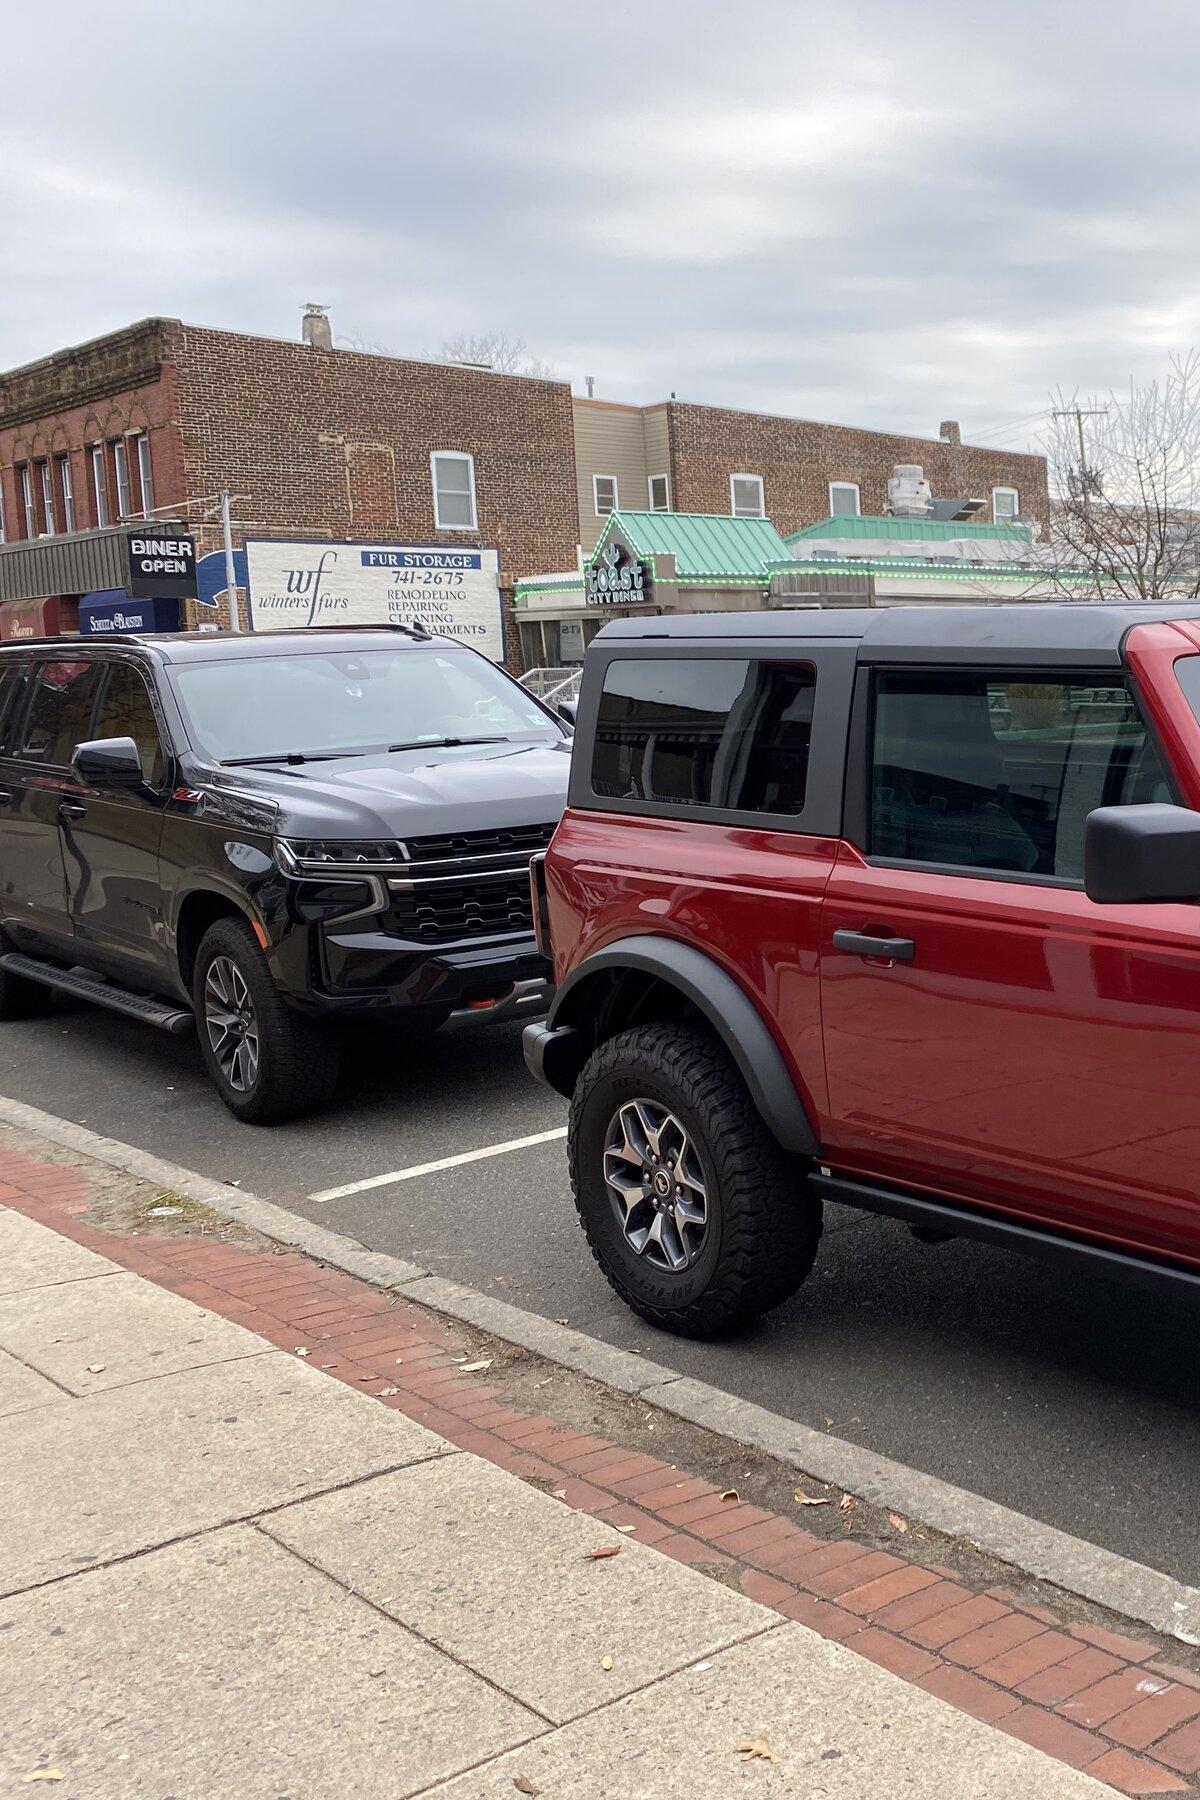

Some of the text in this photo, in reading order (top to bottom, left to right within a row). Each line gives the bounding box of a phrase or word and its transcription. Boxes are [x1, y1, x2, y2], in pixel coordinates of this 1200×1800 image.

[141, 558, 187, 573] OPEN
[369, 553, 473, 568] FUR STORAGE
[392, 571, 464, 585] 741-2675
[586, 560, 643, 593] toast
[387, 589, 467, 600] REMODELING
[587, 591, 611, 604] CITY
[259, 593, 349, 615] winters furs
[388, 602, 449, 612] REPAIRING
[389, 613, 454, 624] CLEANING
[423, 625, 487, 635] GARMENTS
